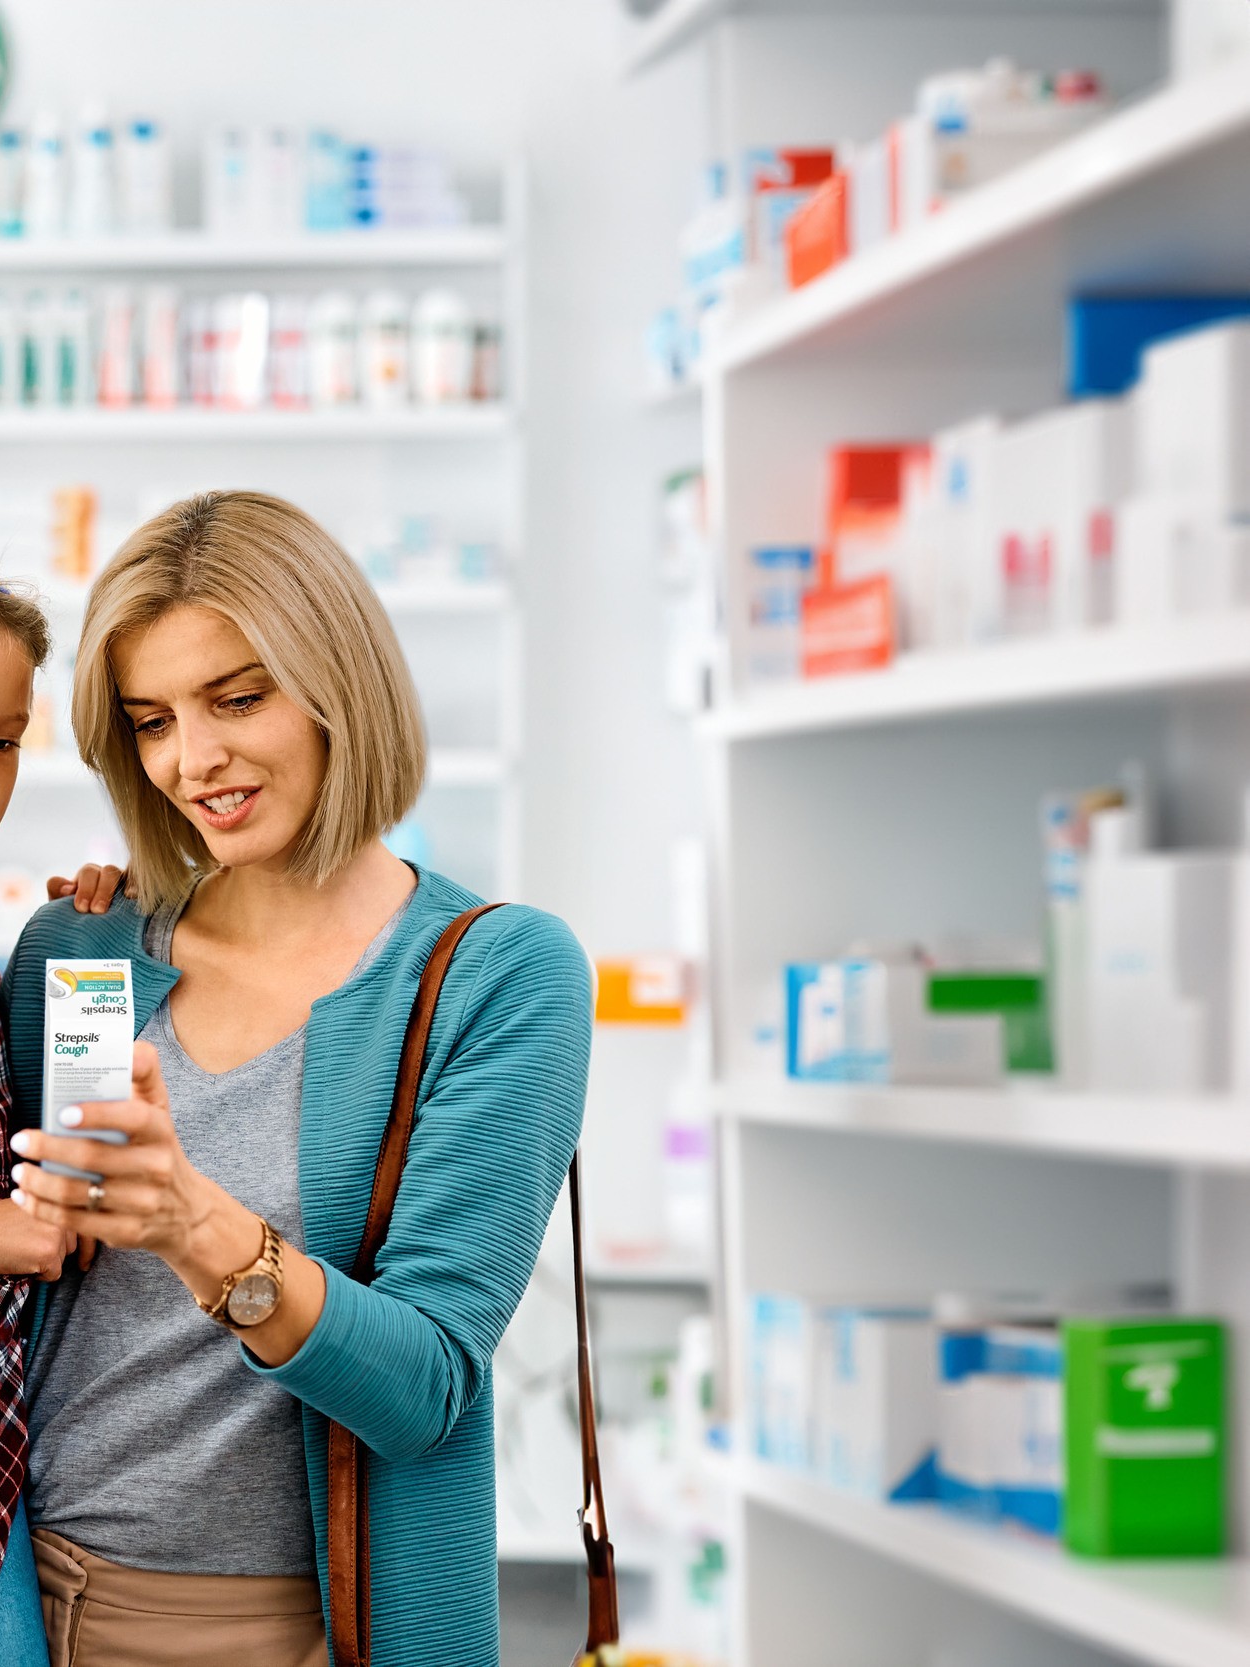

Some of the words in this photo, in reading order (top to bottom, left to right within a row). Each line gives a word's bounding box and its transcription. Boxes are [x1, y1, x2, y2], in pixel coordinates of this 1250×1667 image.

[92, 993, 127, 1005] Cough
[81, 1005, 127, 1015] Strepsils
[54, 1032, 100, 1045] Strepsils
[54, 1044, 88, 1057] Cough
